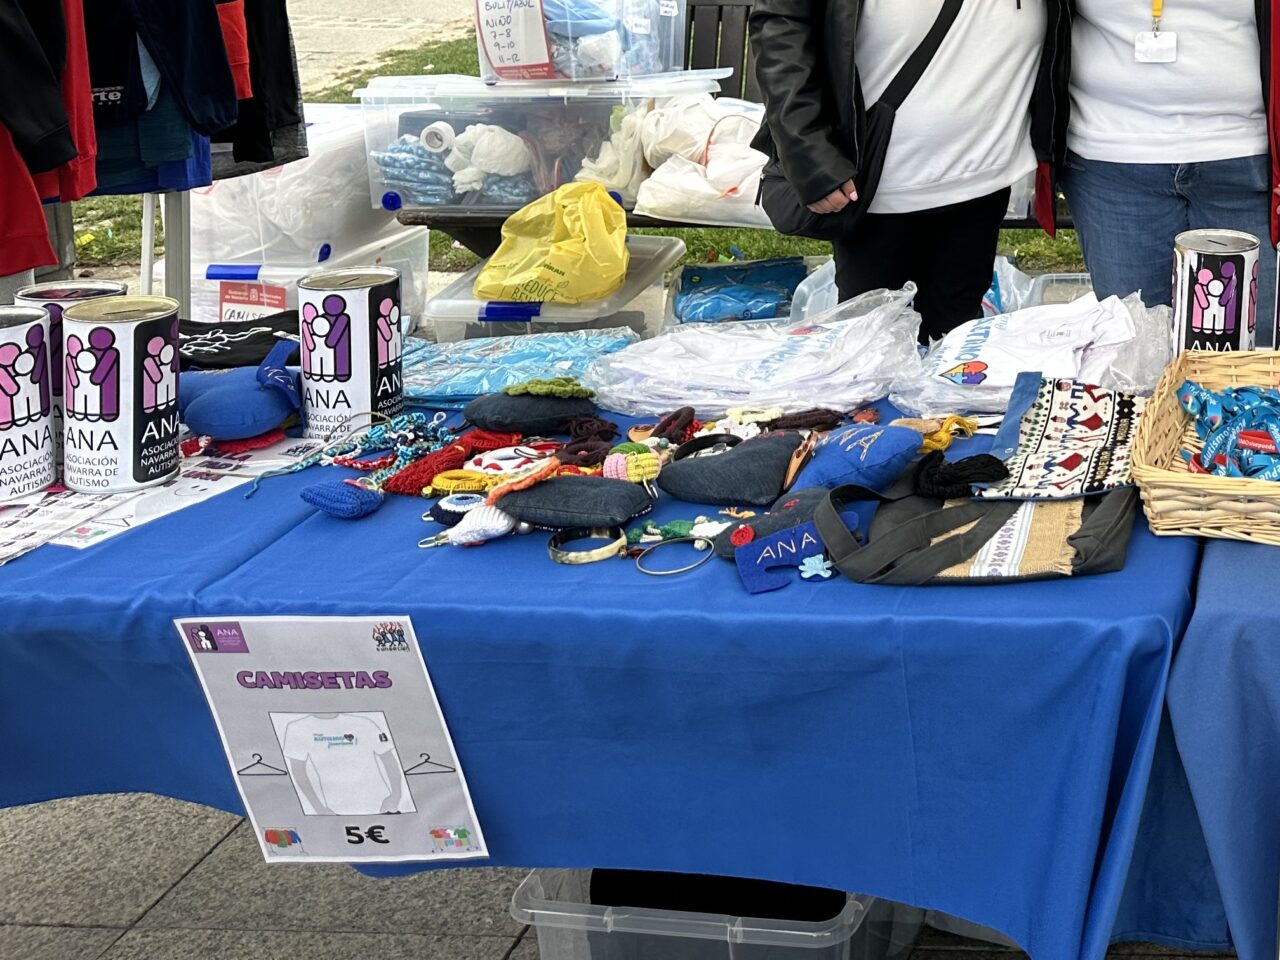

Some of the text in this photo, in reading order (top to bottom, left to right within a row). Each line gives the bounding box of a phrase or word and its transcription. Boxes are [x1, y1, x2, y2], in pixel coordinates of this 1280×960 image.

[304, 387, 352, 409] ANA
[0, 424, 53, 461] ANA
[66, 427, 119, 451] ANA
[69, 477, 110, 488] AUTISMO
[104, 468, 119, 477] DE
[9, 474, 52, 496] AUTISMO
[756, 532, 817, 565] ANA
[217, 628, 239, 637] ANA
[236, 670, 393, 690] CAMISETAS
[345, 824, 390, 845] 5€
